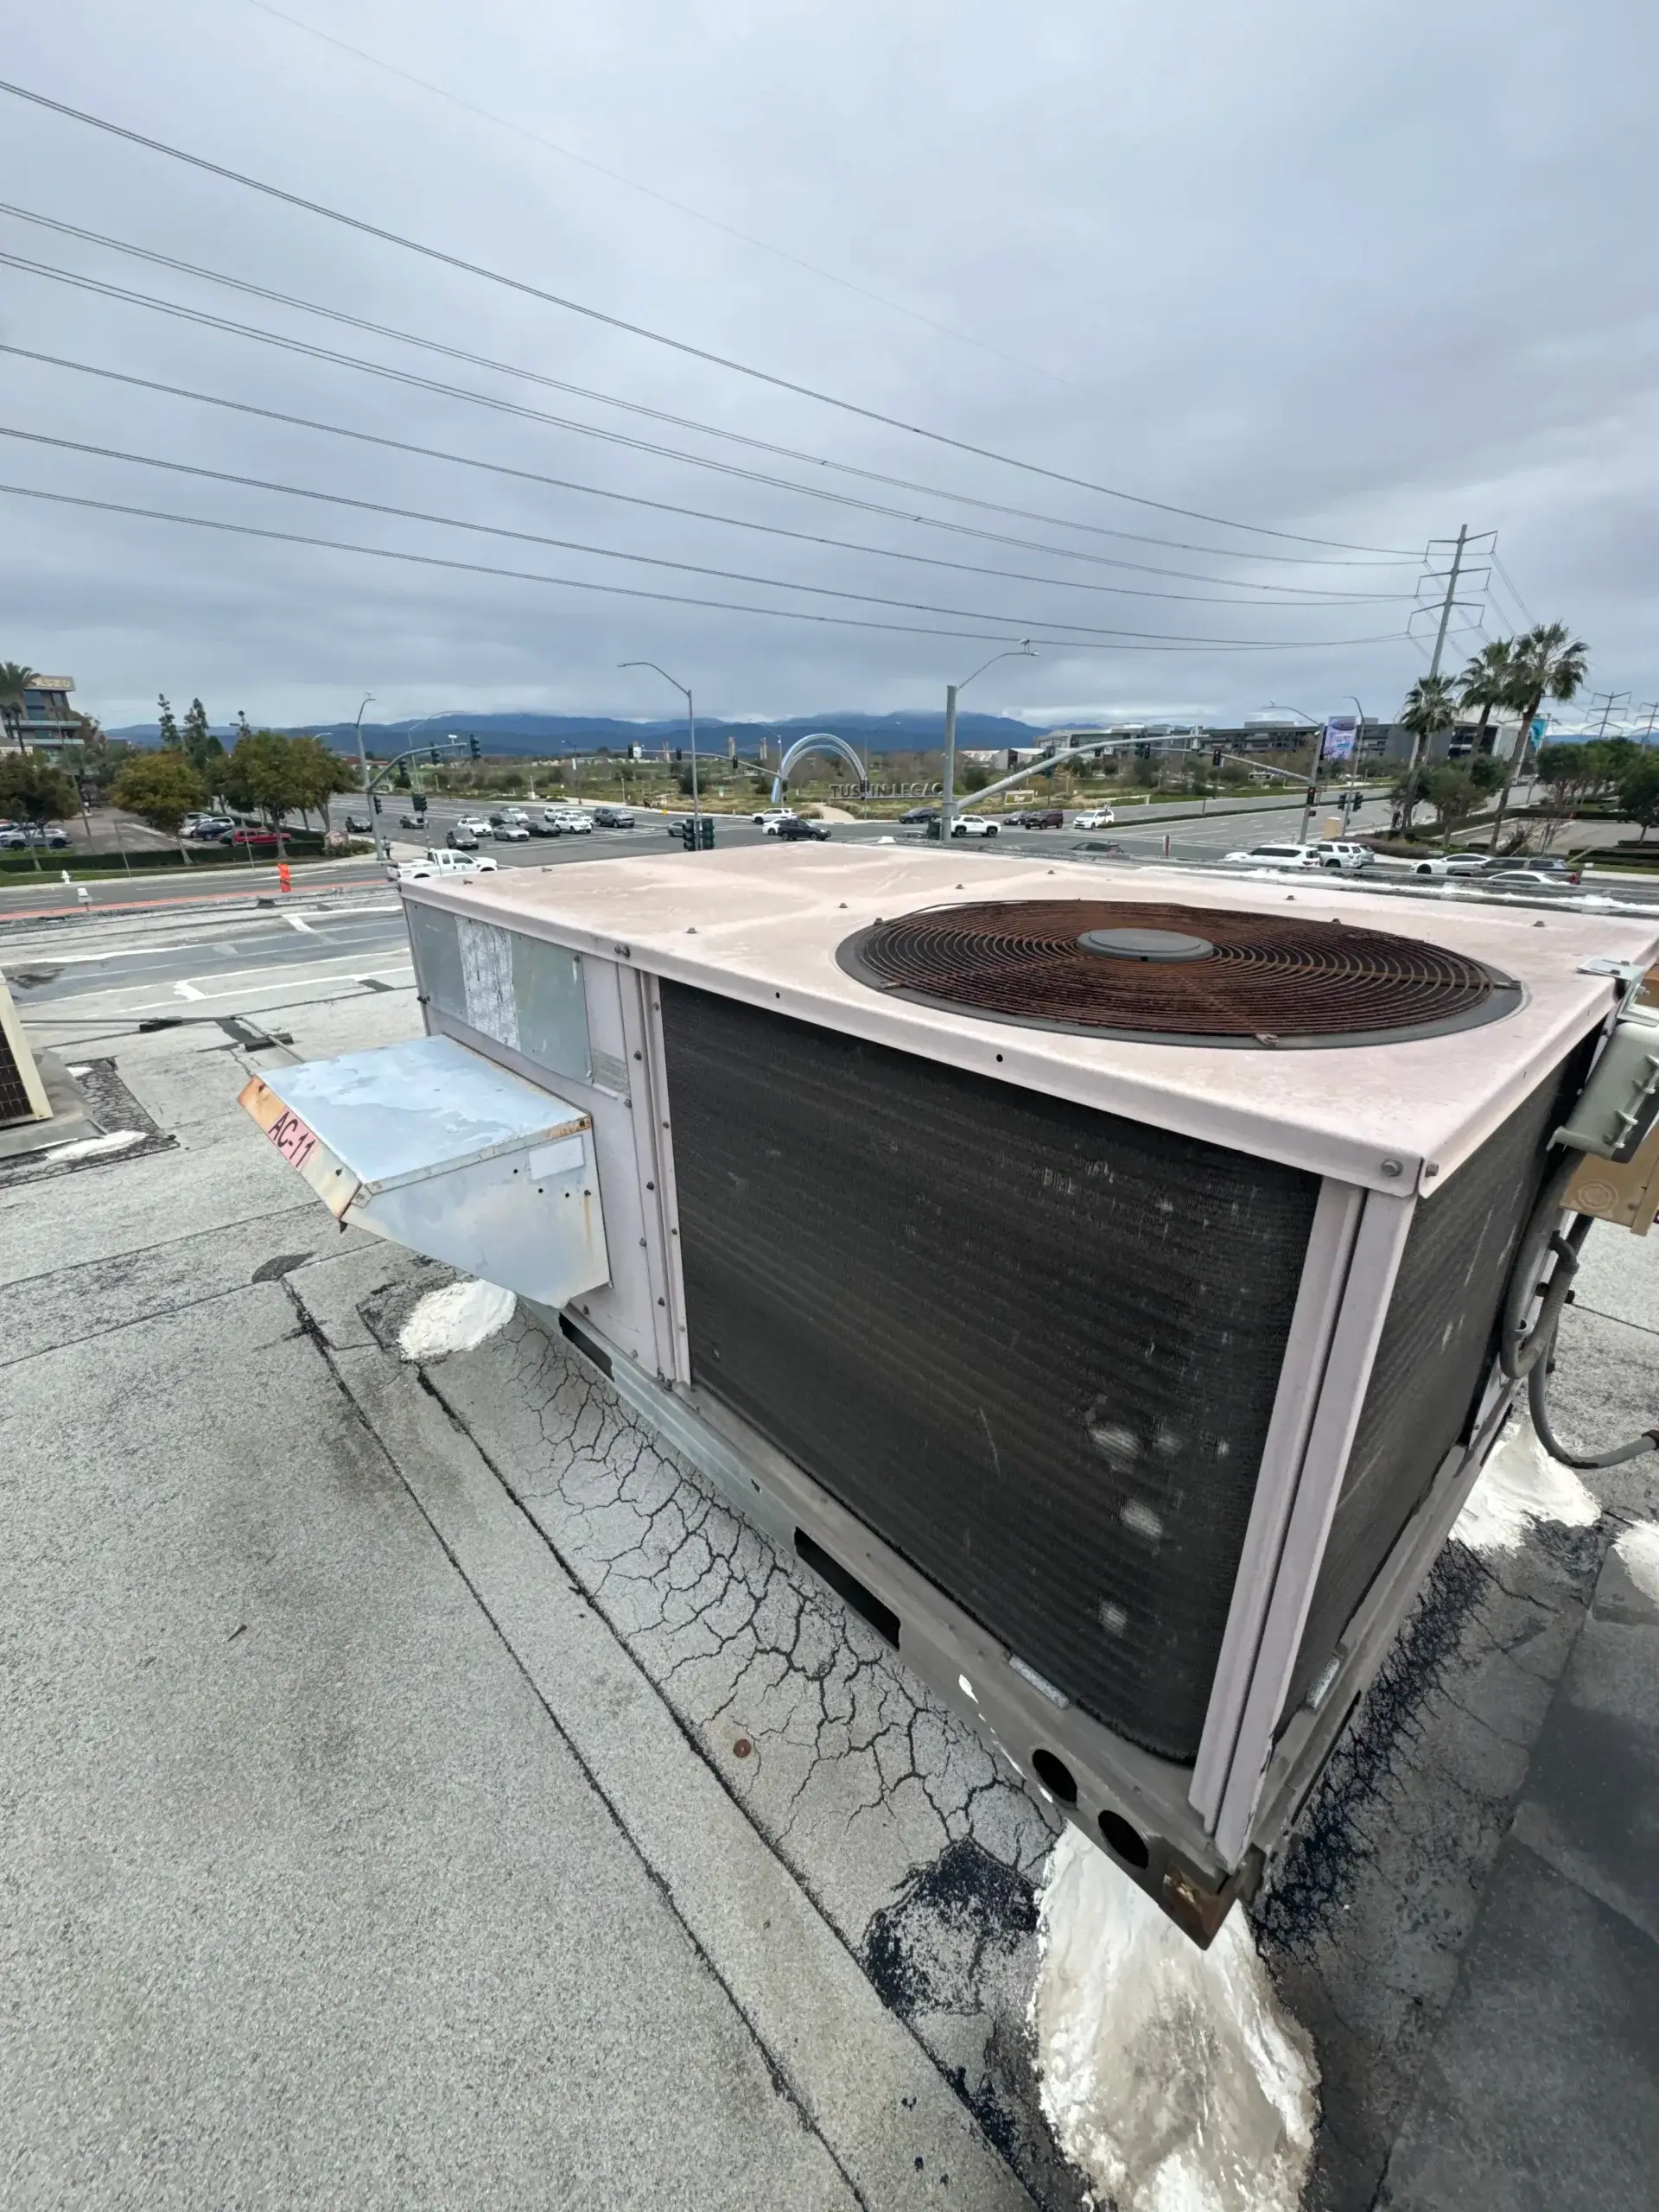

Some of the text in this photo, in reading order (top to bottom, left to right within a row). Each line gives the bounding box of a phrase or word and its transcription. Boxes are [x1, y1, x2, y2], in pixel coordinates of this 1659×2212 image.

[829, 782, 944, 798] TUSIN LEGAC
[268, 1111, 316, 1167] AC-11
